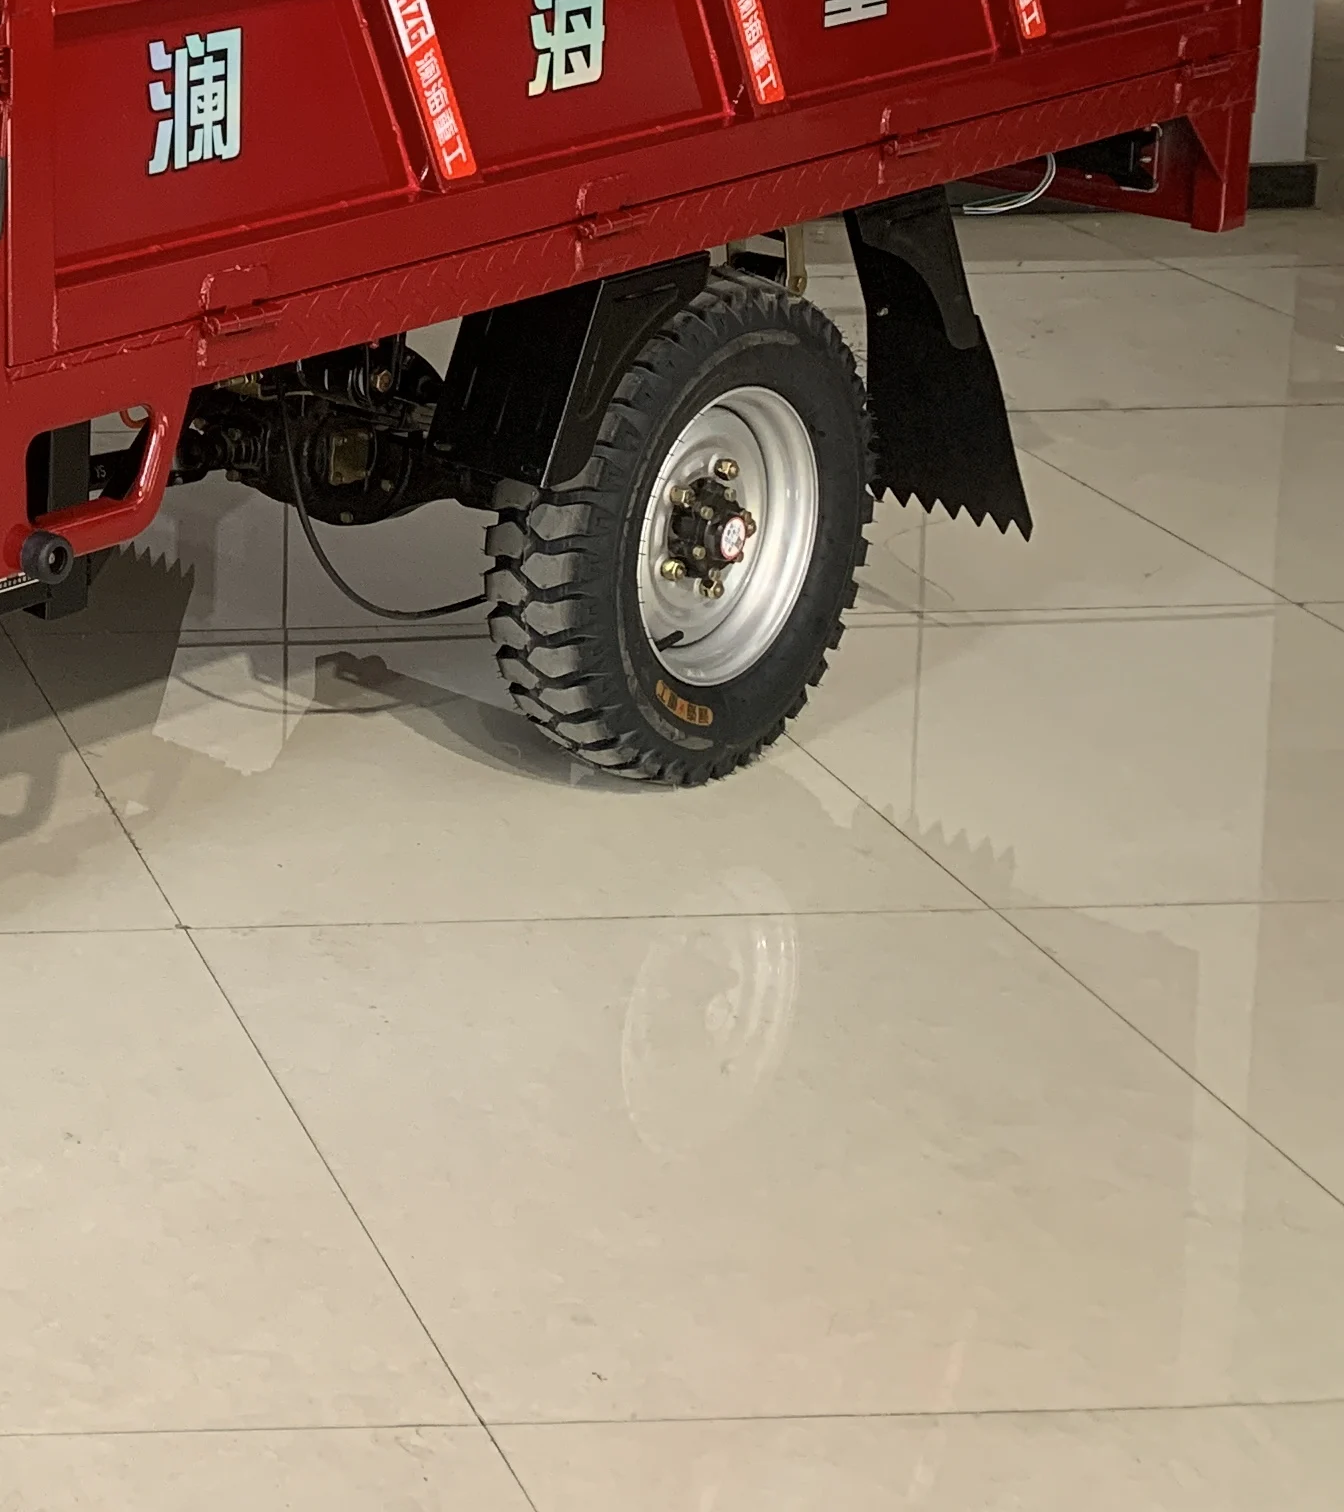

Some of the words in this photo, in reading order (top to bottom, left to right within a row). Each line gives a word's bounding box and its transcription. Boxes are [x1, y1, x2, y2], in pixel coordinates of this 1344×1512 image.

[148, 27, 243, 176] 澜
[415, 48, 468, 176] 澜海重工
